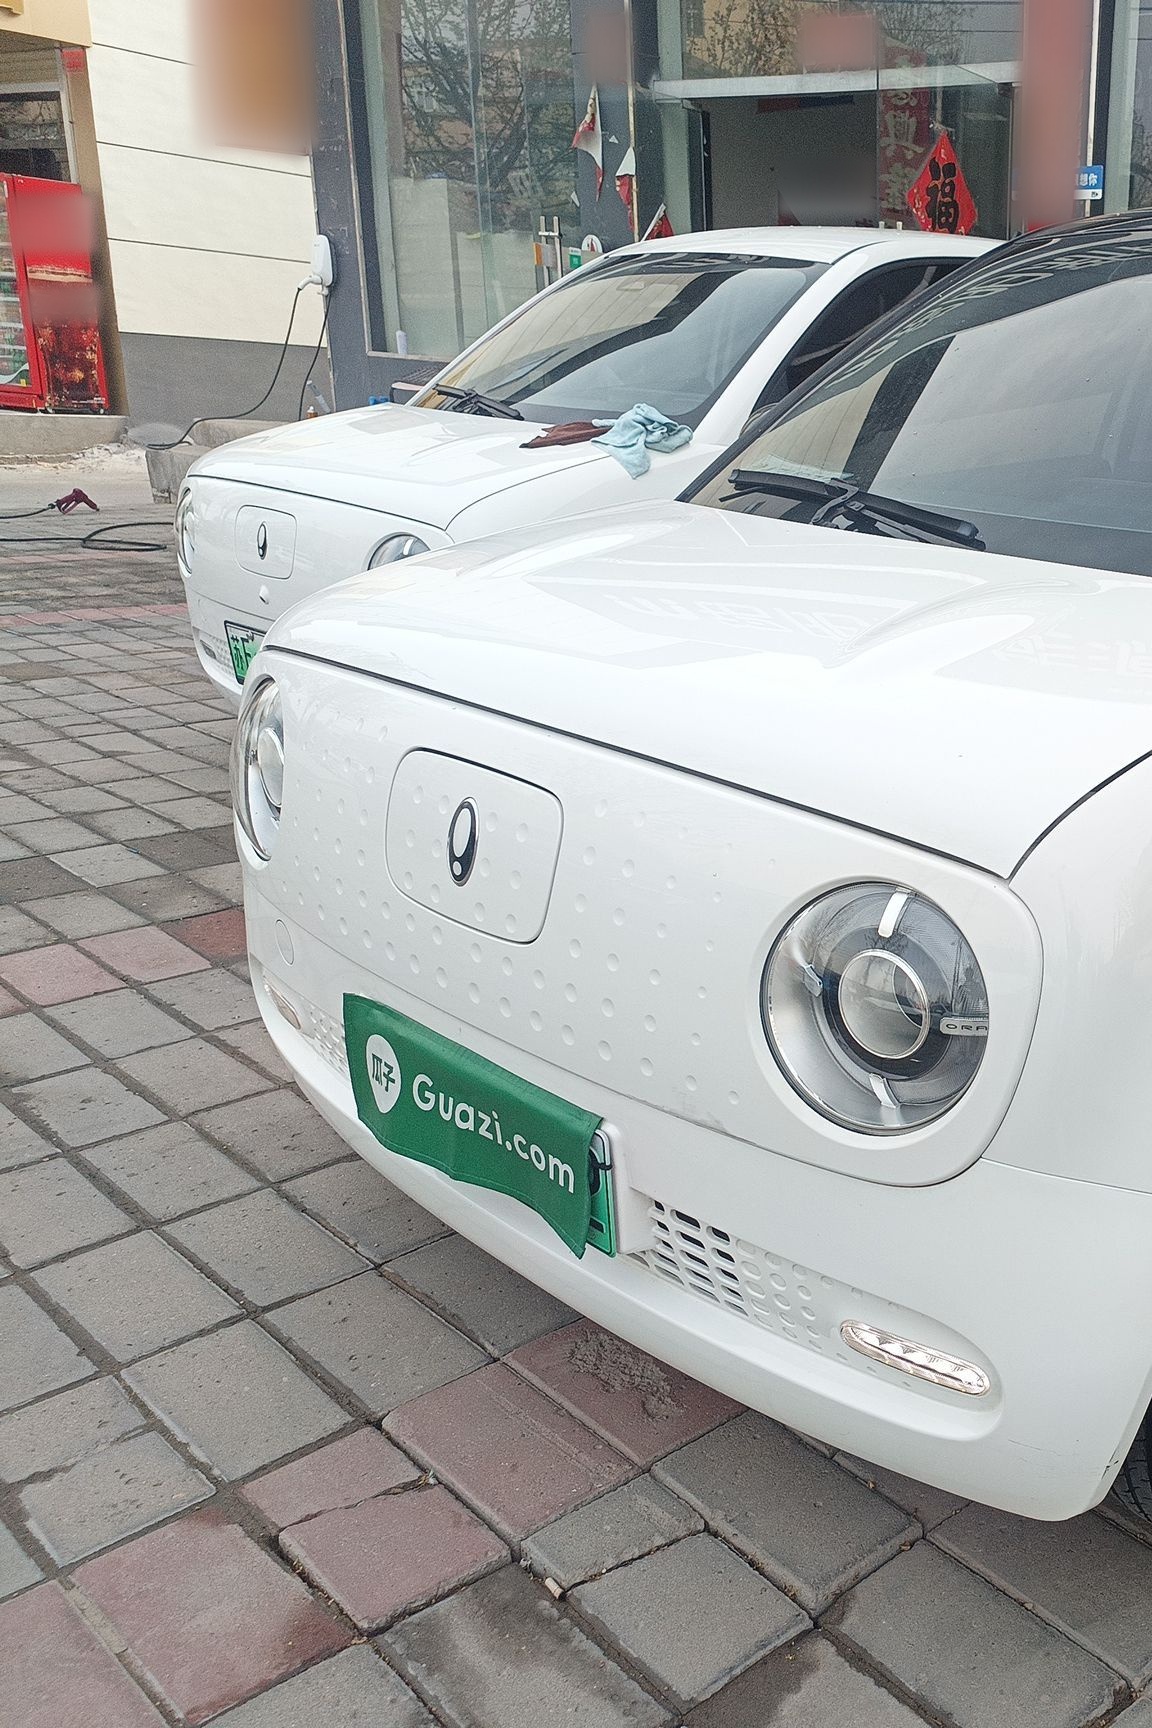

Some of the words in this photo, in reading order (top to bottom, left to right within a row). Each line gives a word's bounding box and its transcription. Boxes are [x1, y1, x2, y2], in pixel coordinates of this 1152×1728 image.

[926, 157, 960, 233] 福
[1075, 173, 1098, 187] 想你
[945, 1023, 988, 1031] ORA
[371, 1053, 395, 1092] 瓜子
[412, 1073, 575, 1194] Guazi.com
